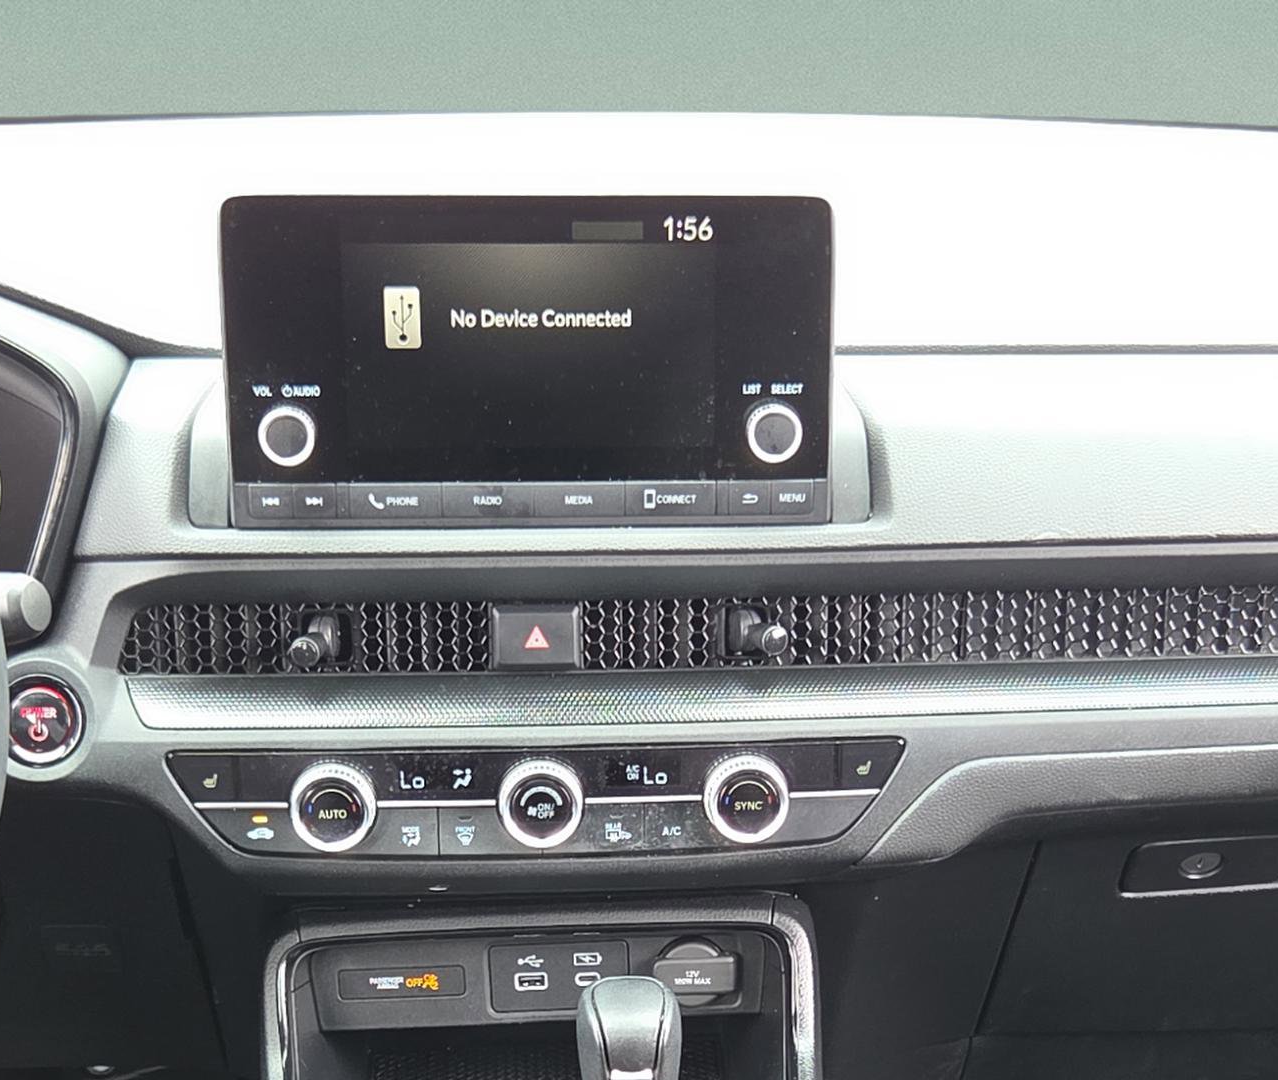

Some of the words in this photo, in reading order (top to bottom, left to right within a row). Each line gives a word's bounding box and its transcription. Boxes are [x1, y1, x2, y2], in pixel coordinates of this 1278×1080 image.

[663, 215, 714, 242] 1:56
[450, 308, 477, 328] No
[480, 308, 539, 328] Device
[541, 308, 633, 328] Connected
[252, 384, 273, 397] VOL
[293, 384, 321, 398] AUDIO
[742, 383, 762, 395] LIST
[771, 382, 804, 395] SELECT
[386, 496, 419, 507] PHONE
[473, 495, 503, 506] RADIO
[564, 495, 593, 505] MEDIA
[656, 494, 697, 505] CONNECT
[779, 493, 806, 503] MENU
[19, 707, 58, 719] POWER
[399, 769, 425, 790] Lo
[643, 765, 668, 785] Lo
[734, 801, 763, 812] SYNC
[318, 809, 348, 820] AUTO
[537, 810, 555, 820] OFF
[662, 825, 681, 837] A/C
[405, 978, 423, 988] OFF
